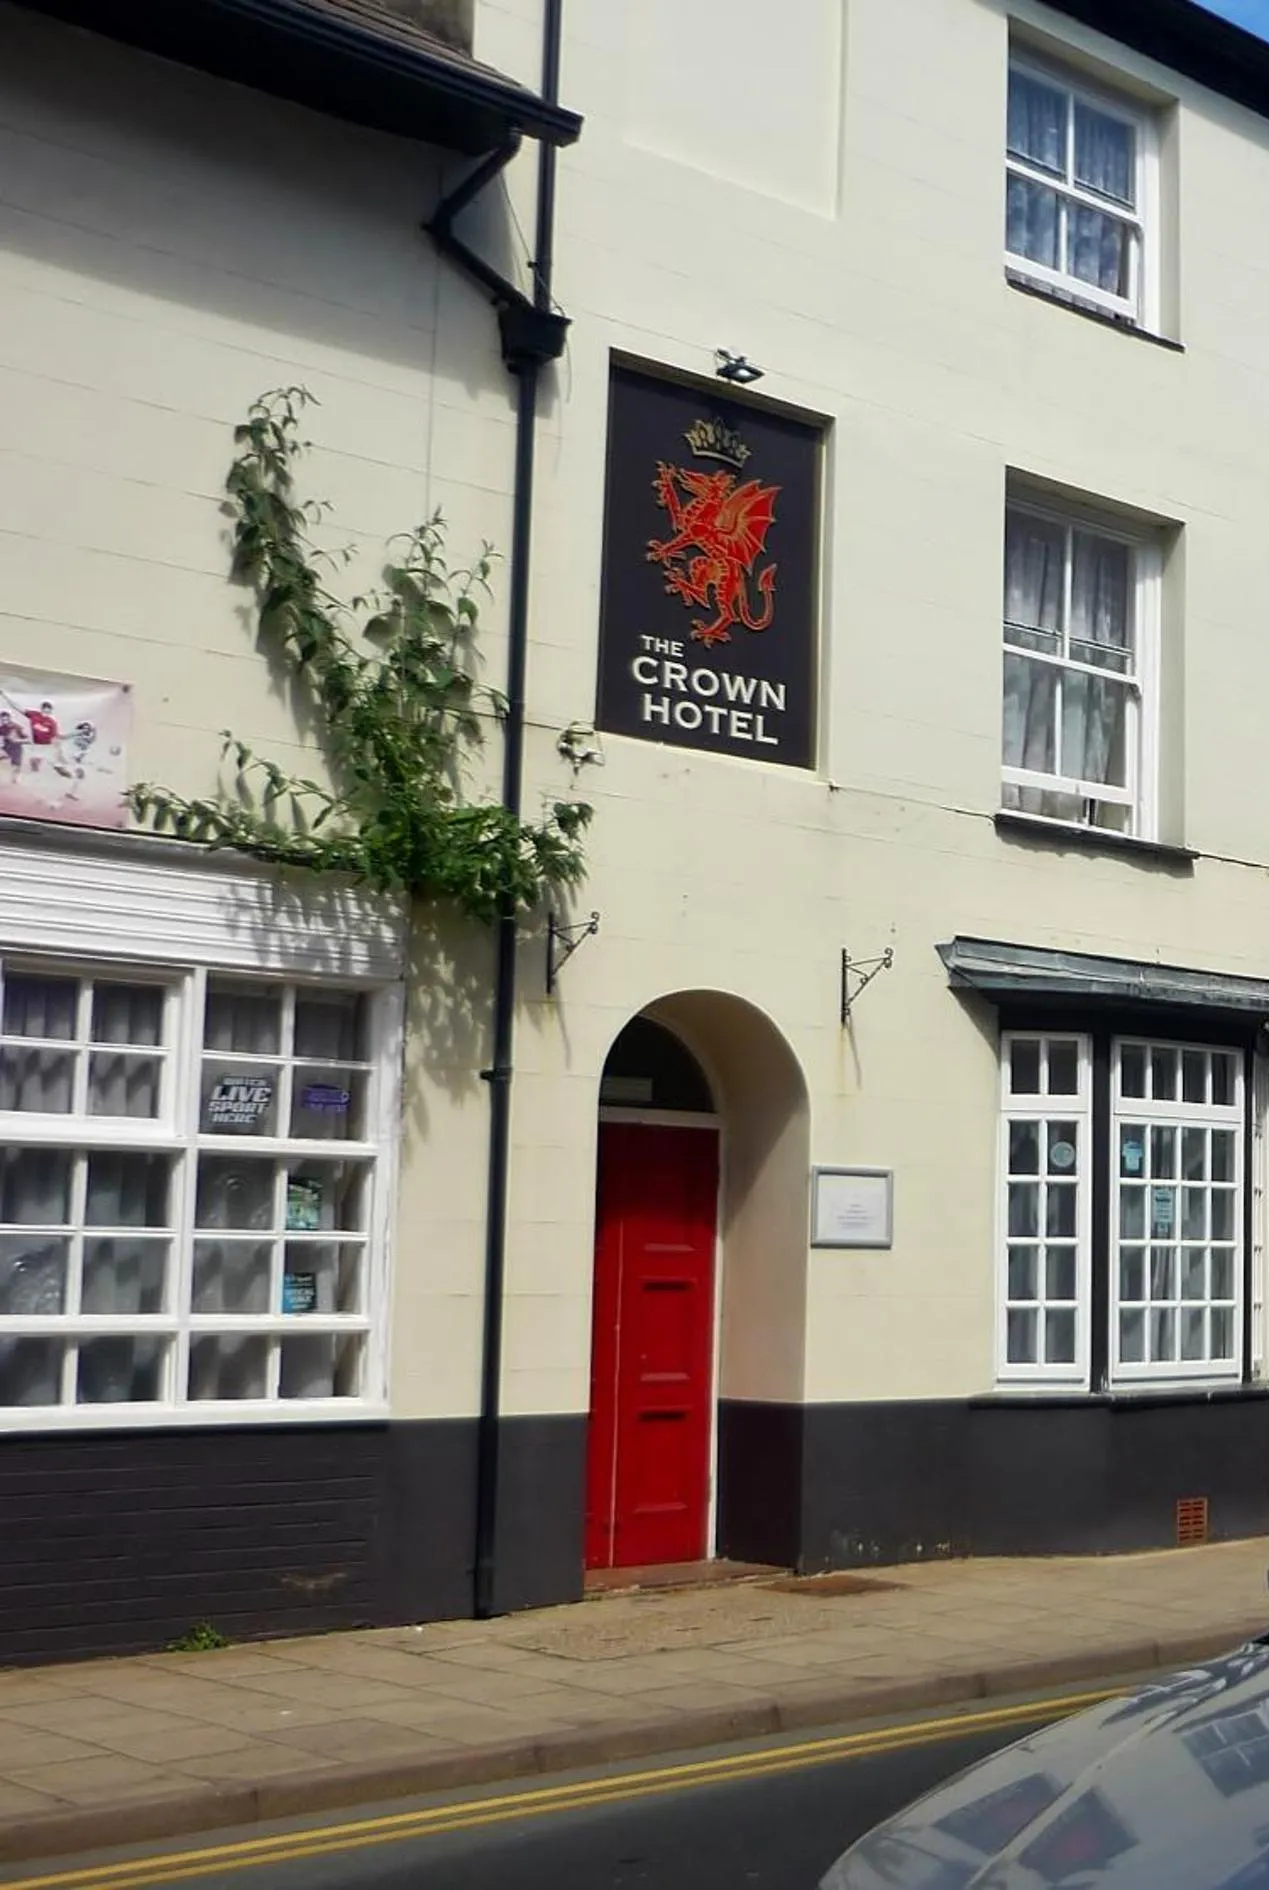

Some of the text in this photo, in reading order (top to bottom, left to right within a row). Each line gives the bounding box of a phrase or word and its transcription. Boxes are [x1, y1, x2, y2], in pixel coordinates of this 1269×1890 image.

[641, 635, 685, 657] THE
[632, 655, 787, 711] CROWN
[642, 693, 779, 745] HOTEL
[210, 1085, 272, 1102] LIVE
[208, 1101, 268, 1114] SPORT
[211, 1113, 258, 1124] HERE
